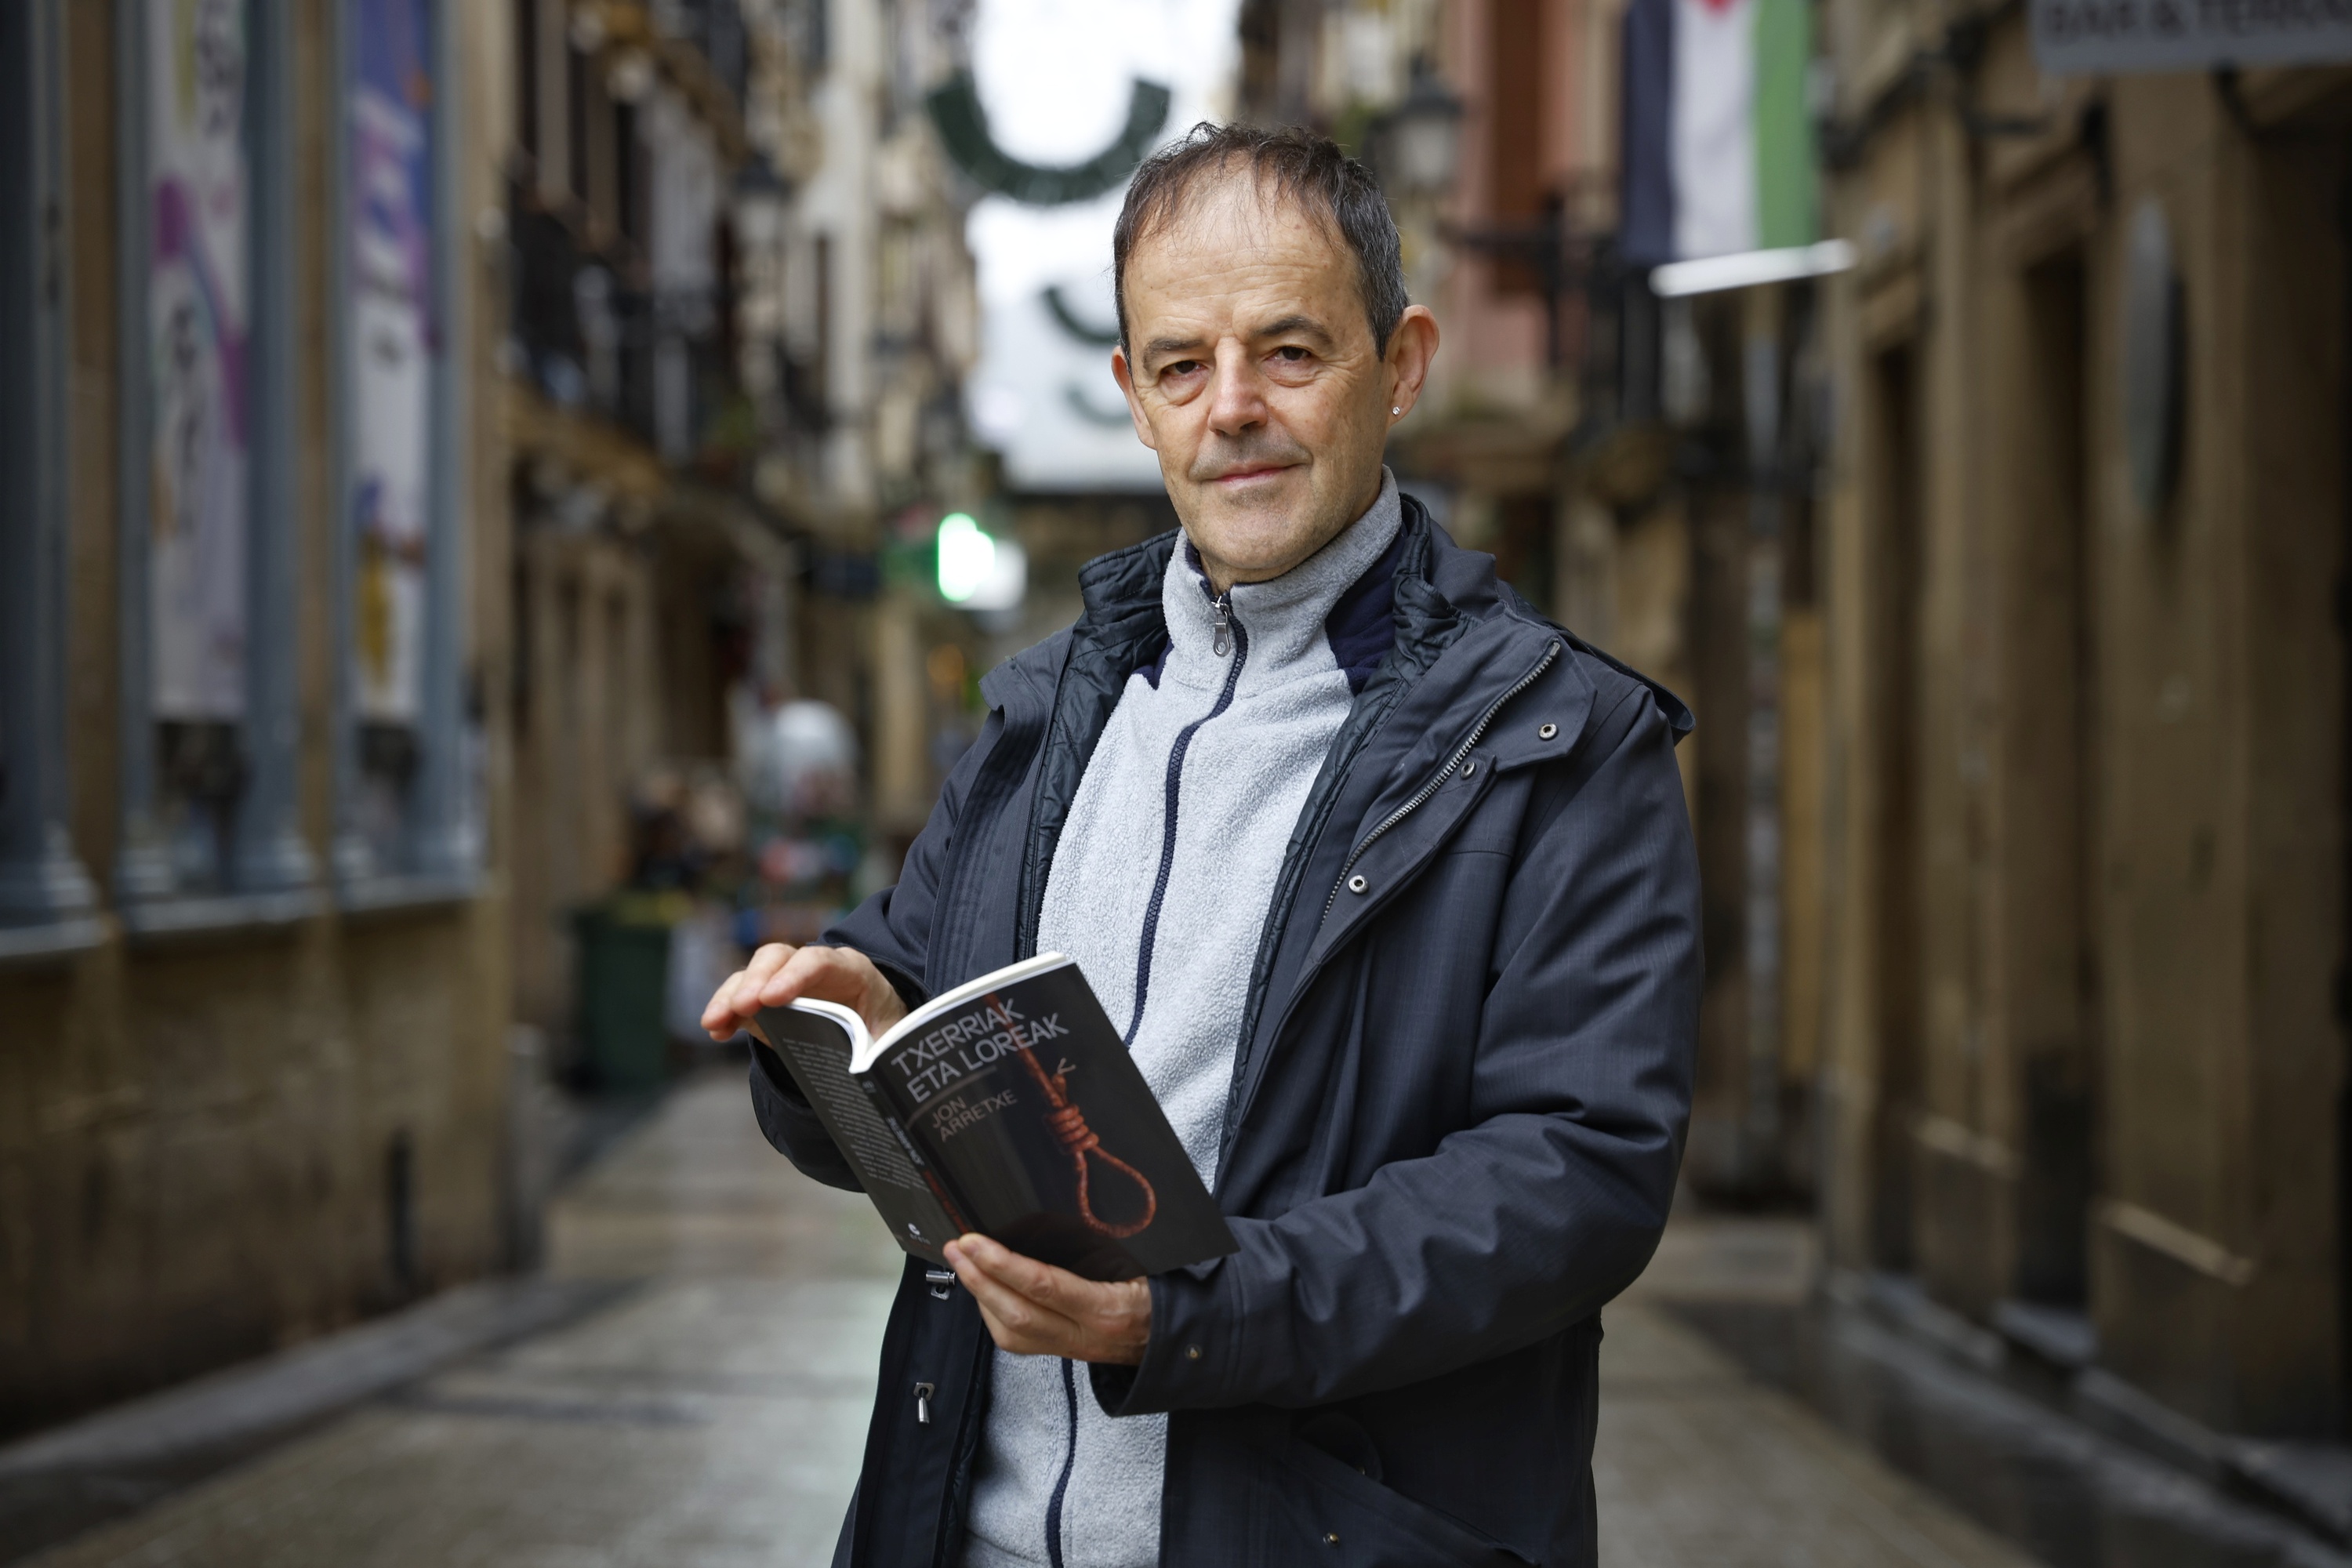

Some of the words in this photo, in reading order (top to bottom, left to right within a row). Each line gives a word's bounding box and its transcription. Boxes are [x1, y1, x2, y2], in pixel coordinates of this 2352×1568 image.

[891, 998, 1025, 1076] TXERRIAK
[906, 1060, 961, 1103] ETA
[959, 1012, 1069, 1071] LOREAK
[932, 1096, 967, 1129] JON
[940, 1089, 1018, 1143] ARRETXE
